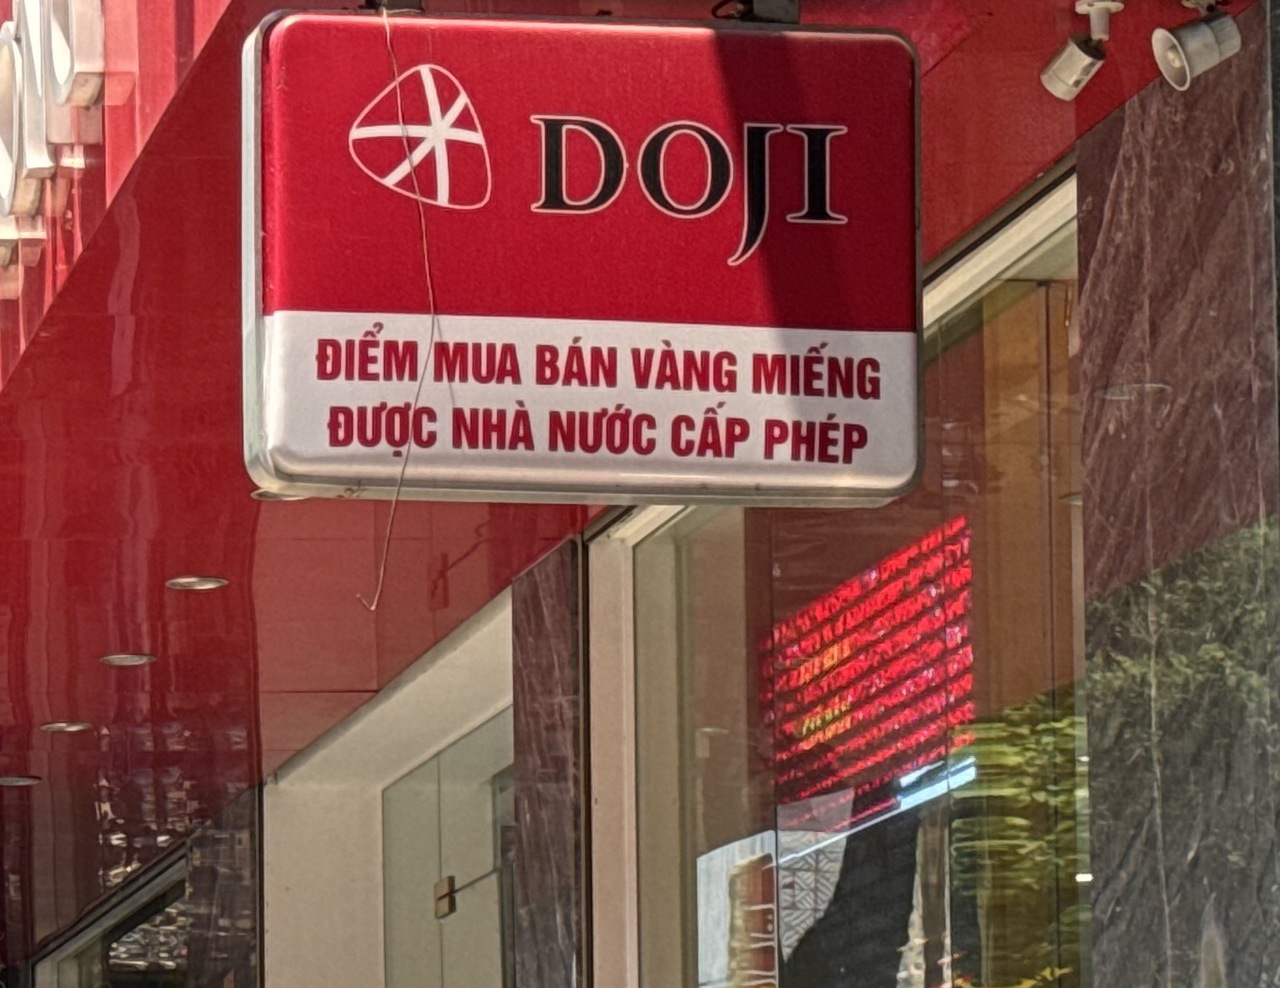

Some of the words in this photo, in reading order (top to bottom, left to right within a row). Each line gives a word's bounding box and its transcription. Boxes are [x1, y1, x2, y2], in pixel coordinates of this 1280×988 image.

[530, 115, 848, 266] DOJI
[315, 322, 419, 381] ĐIỂM
[434, 342, 521, 384] MUA
[536, 337, 618, 387] BÁN
[632, 339, 737, 393] VÀNG
[752, 342, 881, 400] MIẾNG
[327, 402, 437, 458] ĐƯỢC
[452, 400, 534, 450] NHÀ
[548, 407, 657, 455] NƯỚC
[671, 401, 751, 458] CẤP
[763, 413, 870, 464] PHÉP
